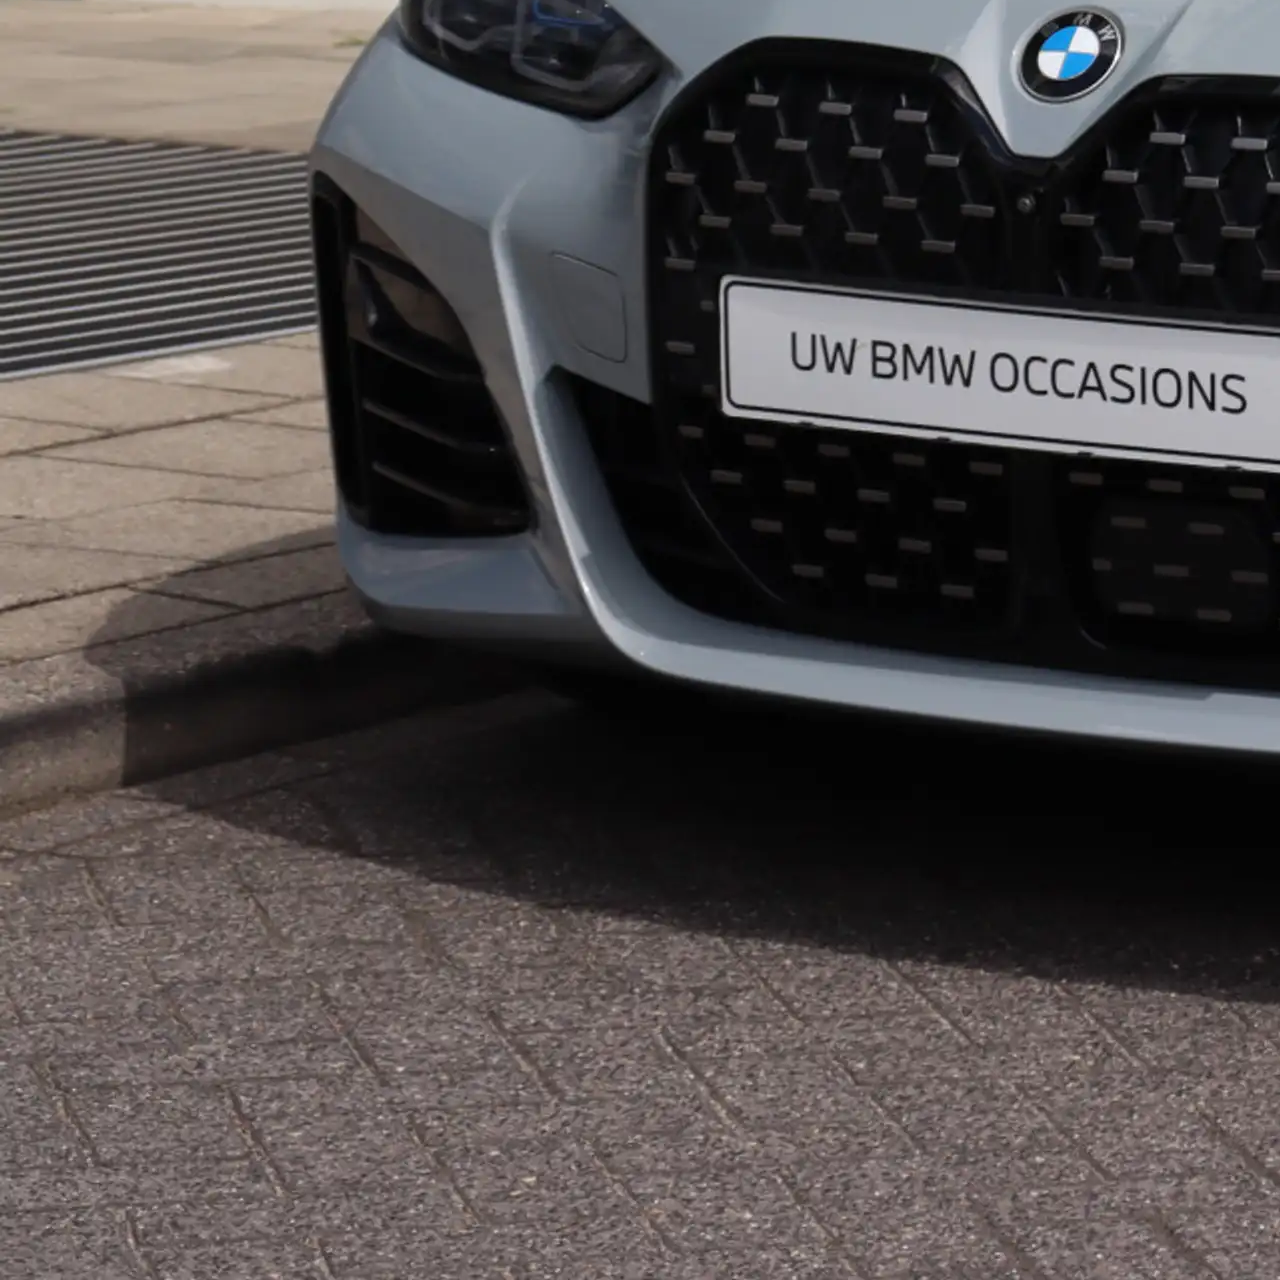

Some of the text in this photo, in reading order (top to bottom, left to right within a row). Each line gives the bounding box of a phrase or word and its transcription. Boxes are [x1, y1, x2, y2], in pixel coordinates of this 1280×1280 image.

[790, 332, 1247, 414] UW BMW OCCASIONS
